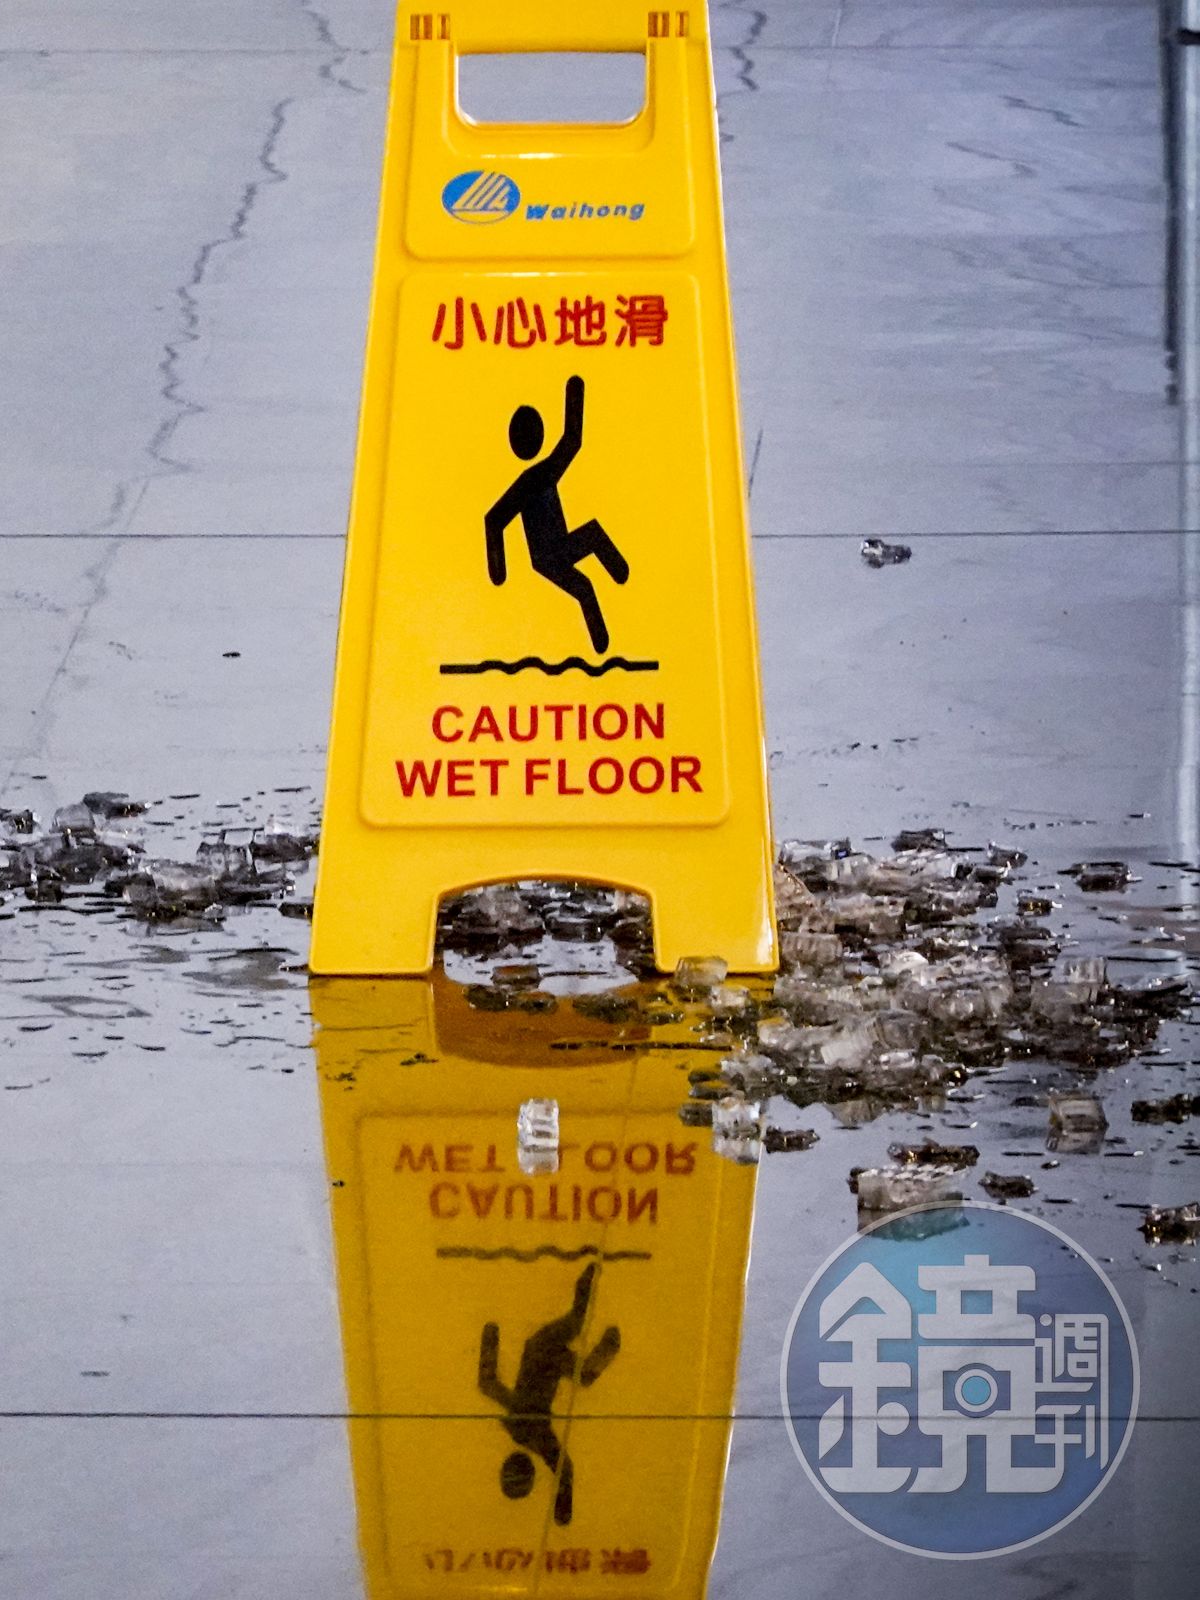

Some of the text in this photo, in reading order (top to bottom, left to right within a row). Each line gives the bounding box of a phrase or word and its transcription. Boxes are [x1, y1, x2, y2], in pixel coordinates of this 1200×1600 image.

[525, 202, 645, 221] Waihong
[431, 295, 669, 350] 小心地滑
[431, 703, 665, 743] CAUTION
[396, 756, 703, 798] WET FLOOR
